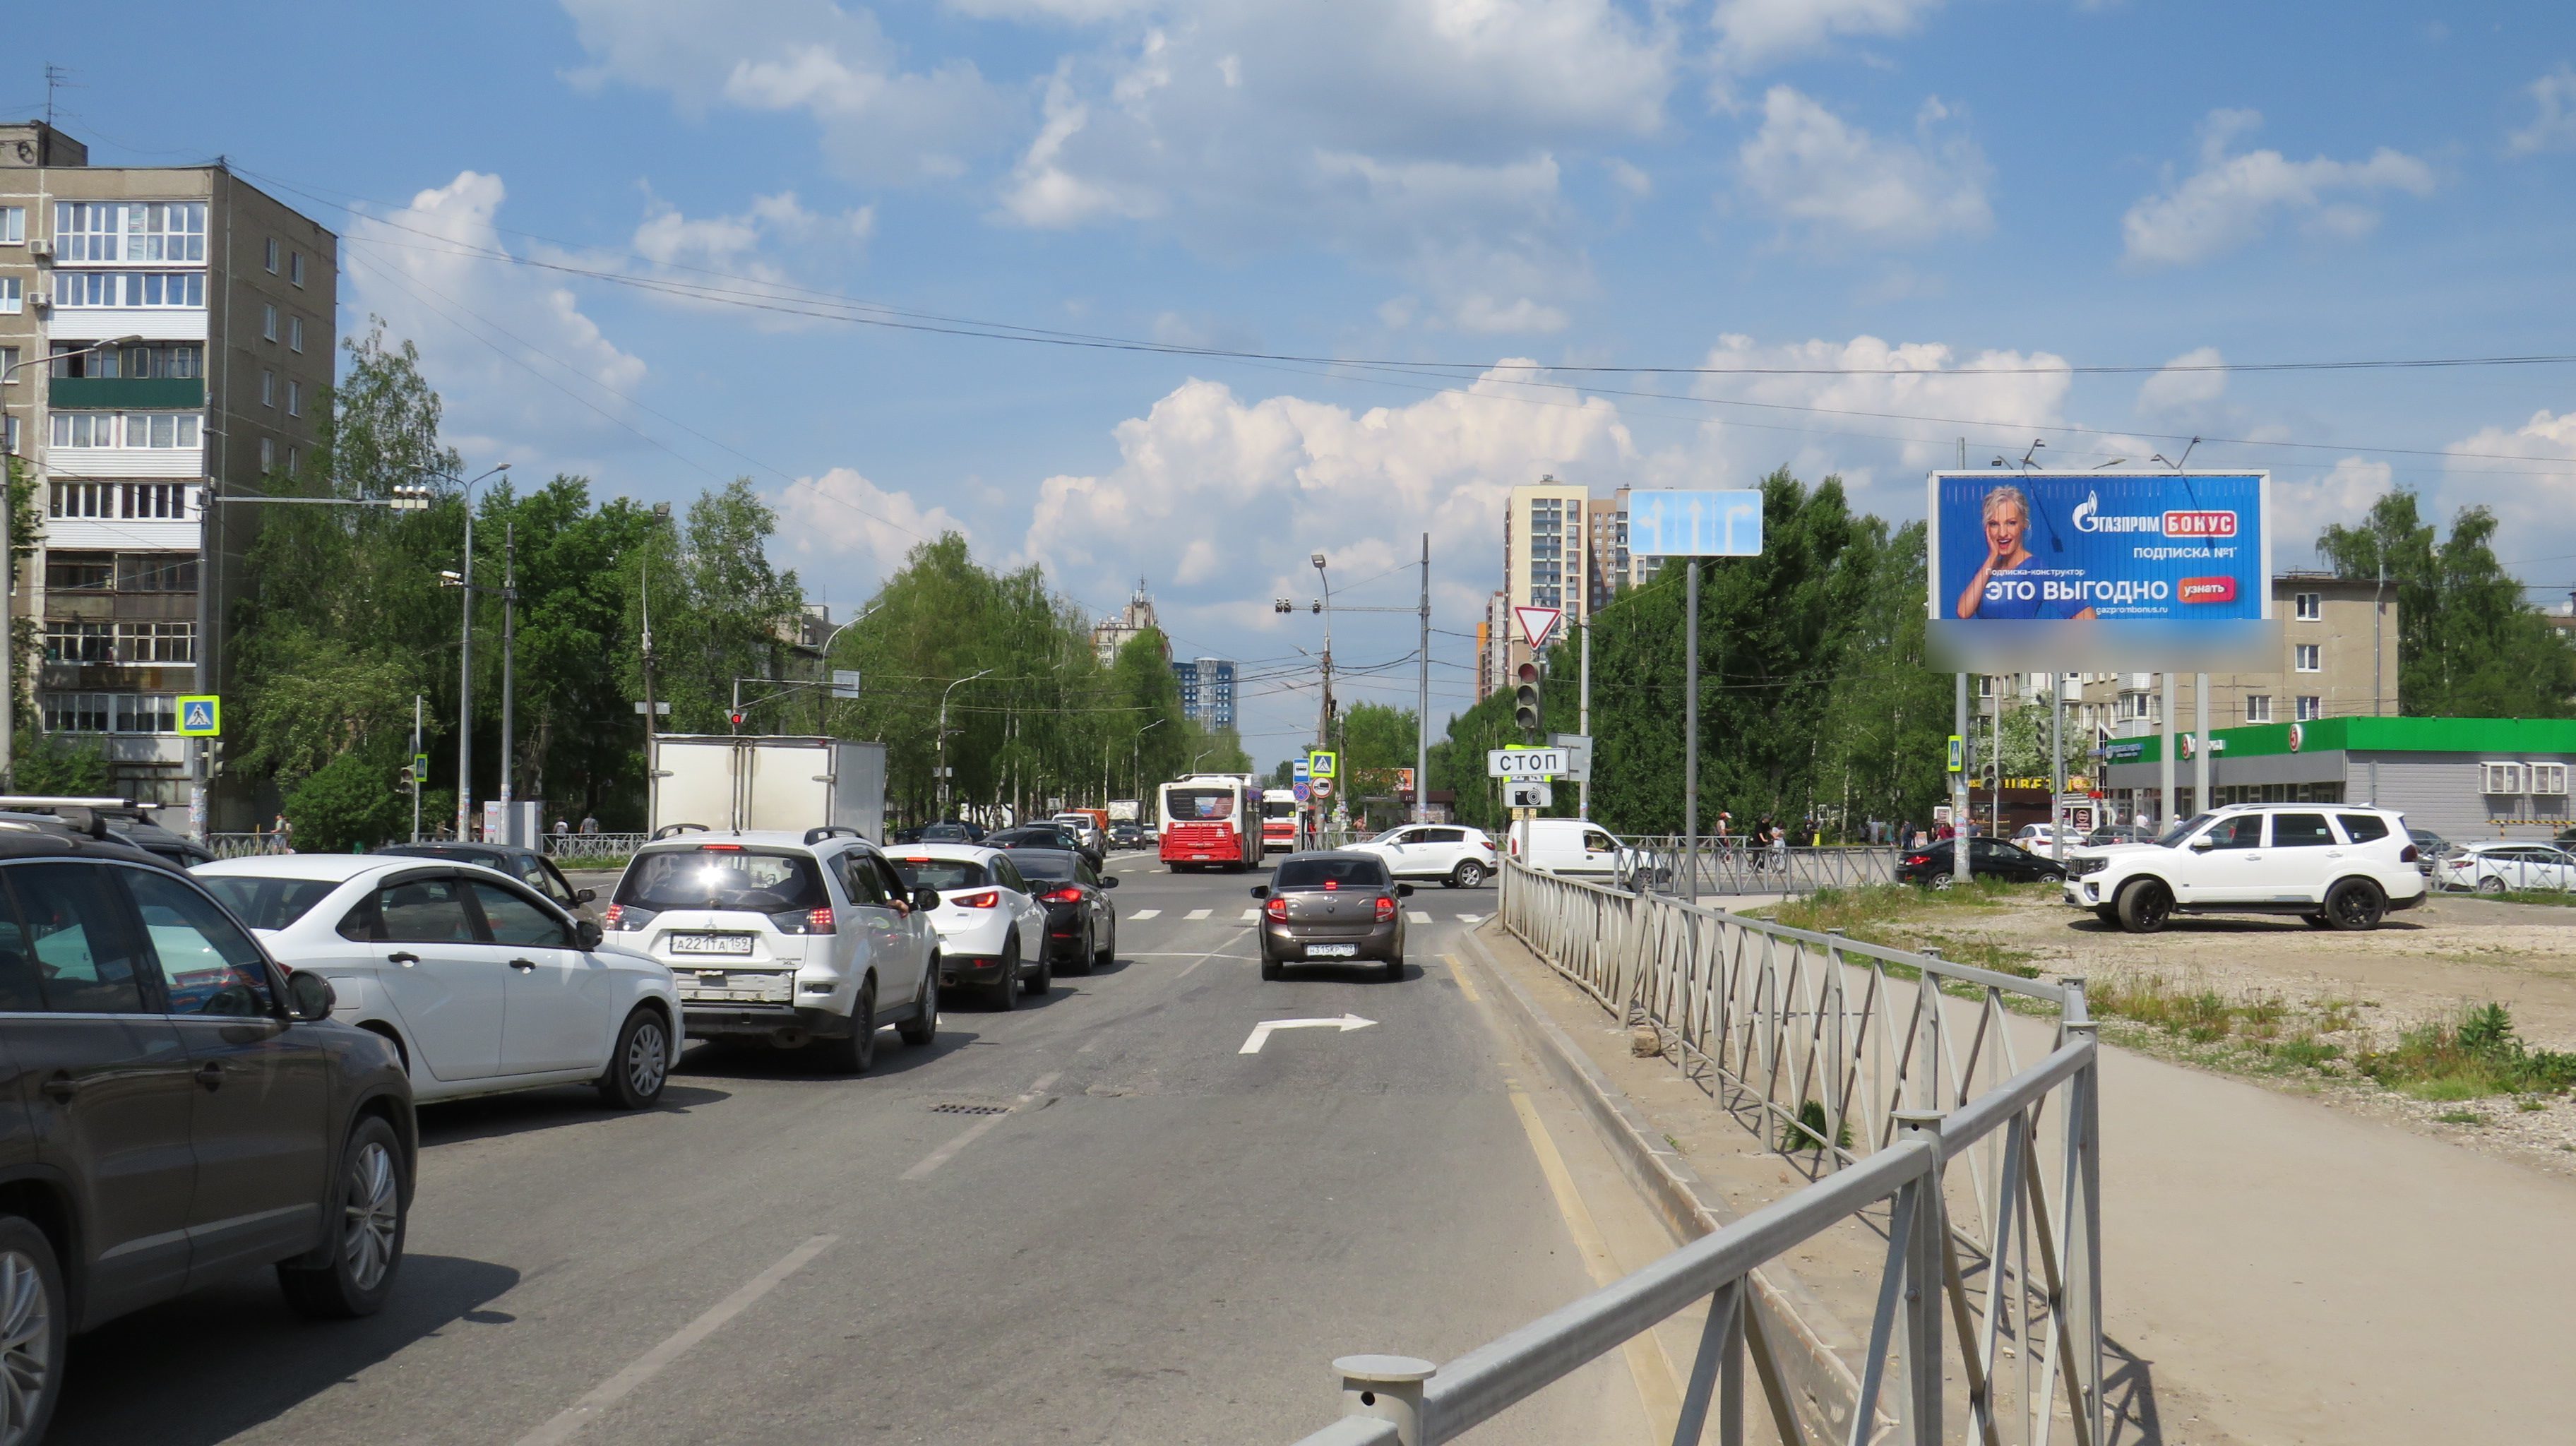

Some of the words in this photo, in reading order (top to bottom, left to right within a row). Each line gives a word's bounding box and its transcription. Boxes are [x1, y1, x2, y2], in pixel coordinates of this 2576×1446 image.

[2099, 515, 2159, 532] ГАЗПРОМ
[2168, 515, 2231, 532] БОНУС
[2133, 547, 2211, 560] ПОДПИСКА
[1985, 568, 2085, 577] Подписка-конструктор
[1985, 580, 2036, 601] ЭТО
[2043, 580, 2169, 604] ВЫГОДНО
[2184, 584, 2225, 597] узнать
[2096, 606, 2169, 614] gazprombonus.ru
[1500, 754, 1556, 771] СТОП
[2004, 778, 2073, 791] ЦВЕ
[677, 938, 726, 950] А221ТА
[729, 938, 747, 948] 159
[1310, 945, 1339, 954] Н315КР
